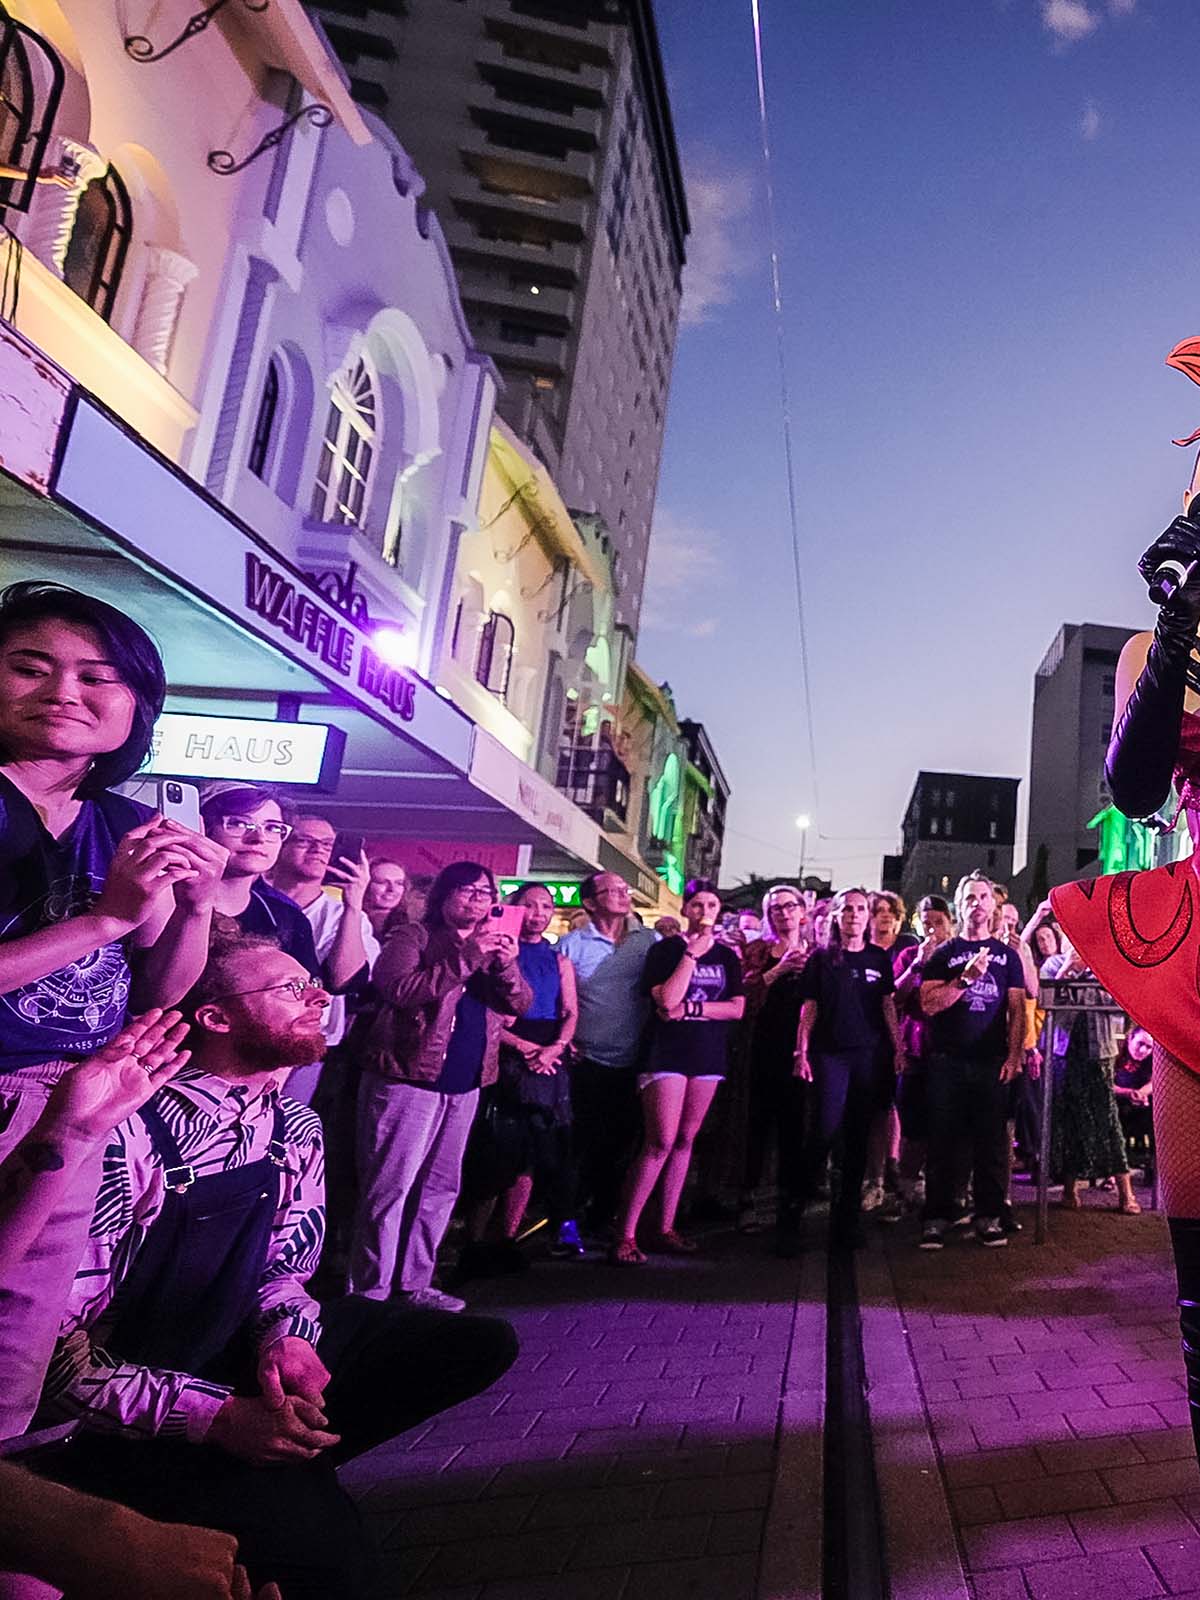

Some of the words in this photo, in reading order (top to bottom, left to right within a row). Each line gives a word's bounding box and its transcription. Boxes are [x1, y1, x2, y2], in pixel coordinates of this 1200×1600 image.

[245, 552, 354, 676] WAFFLE
[358, 645, 416, 721] HAUS
[185, 733, 293, 766] HAUS
